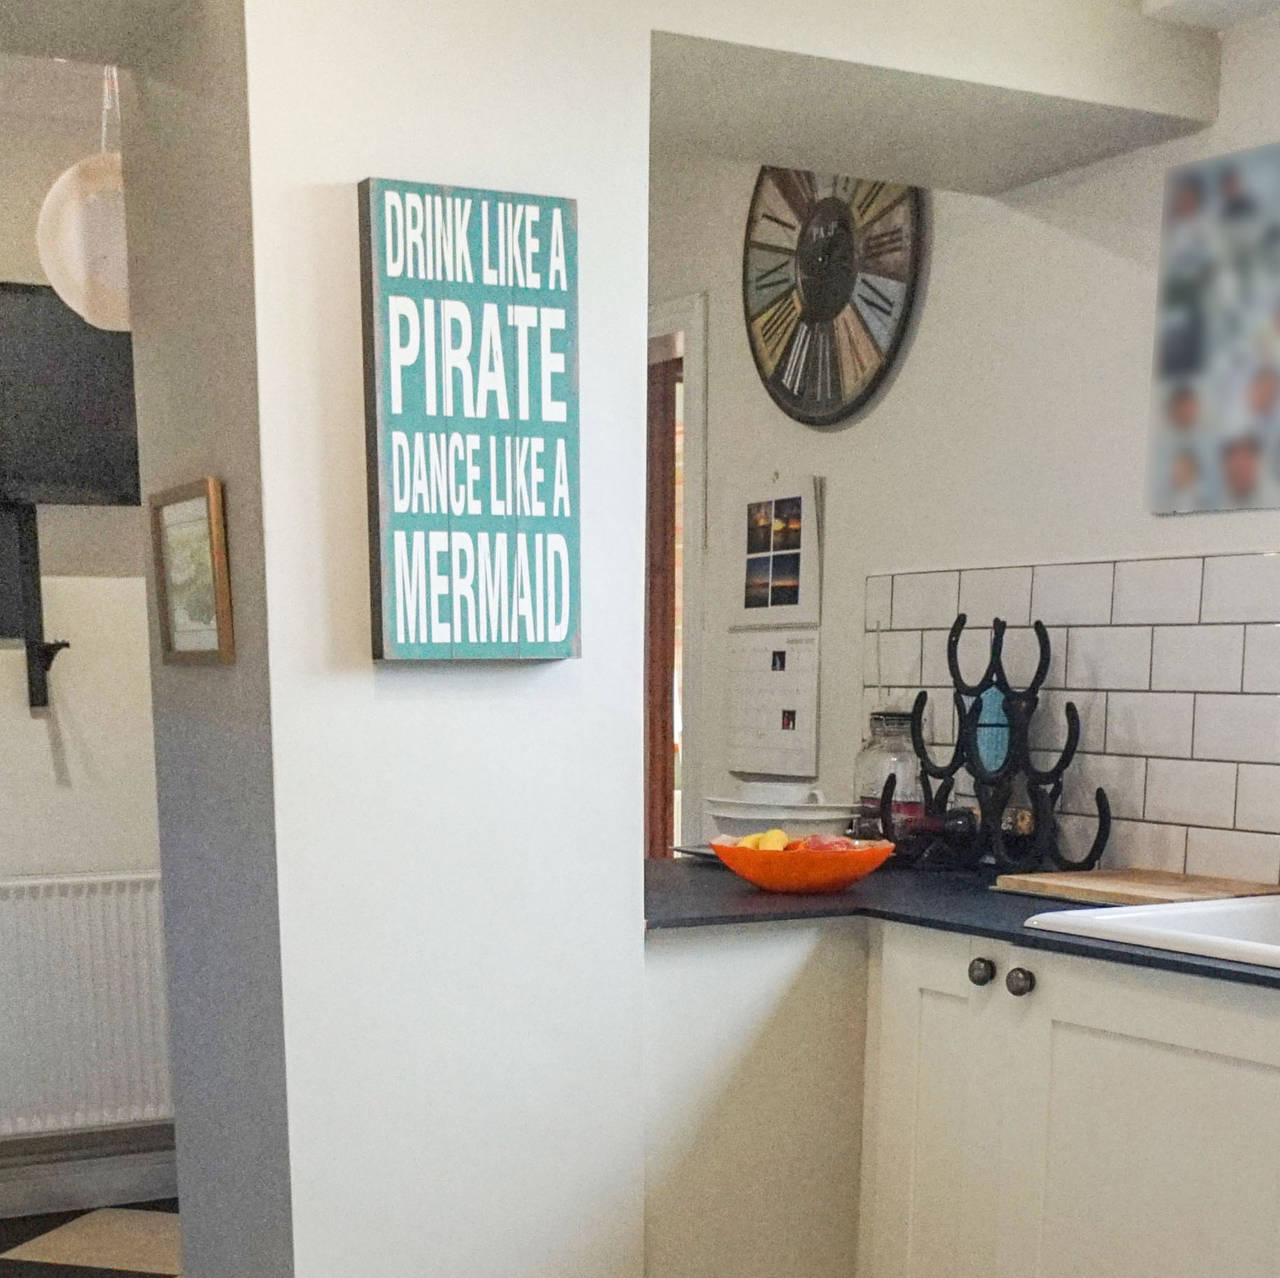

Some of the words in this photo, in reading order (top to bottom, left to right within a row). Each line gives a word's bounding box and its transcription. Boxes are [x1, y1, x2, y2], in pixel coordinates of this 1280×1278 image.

[384, 190, 473, 284] DRINK
[482, 200, 541, 290] LIKE
[548, 208, 568, 291] A
[388, 296, 568, 422] PIRATE
[391, 431, 481, 516] DANCE
[490, 436, 545, 518] LIKE
[553, 439, 571, 518] A
[393, 530, 570, 644] MERMAID
